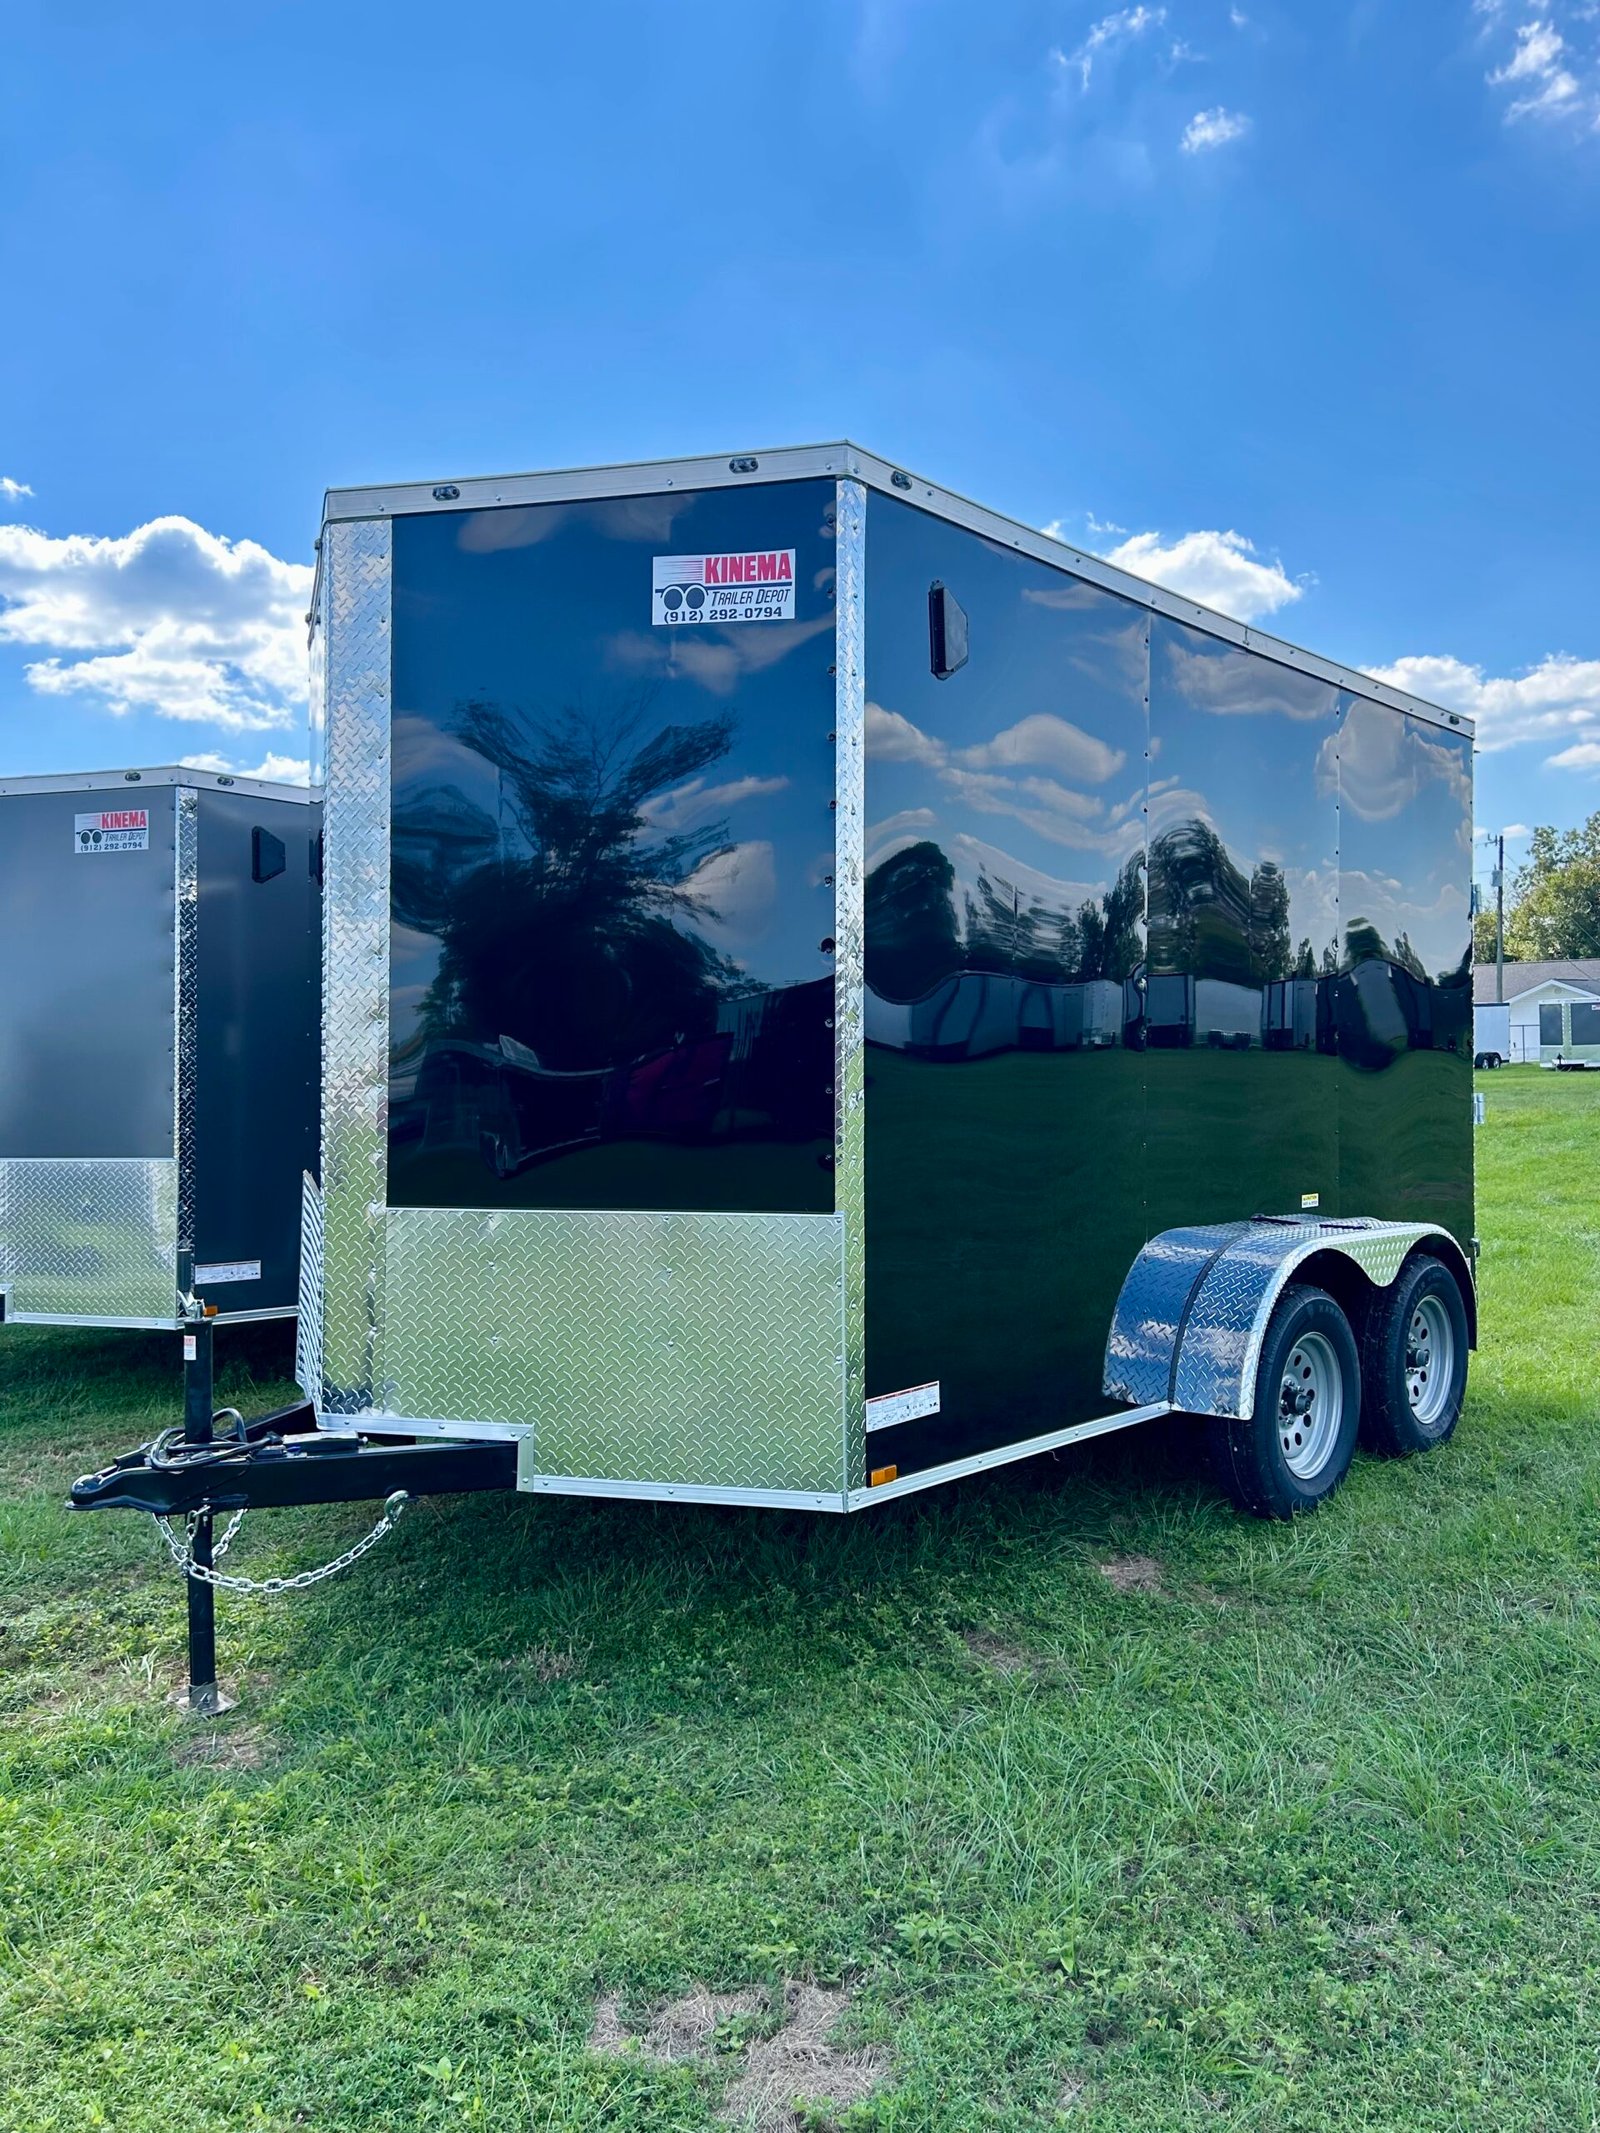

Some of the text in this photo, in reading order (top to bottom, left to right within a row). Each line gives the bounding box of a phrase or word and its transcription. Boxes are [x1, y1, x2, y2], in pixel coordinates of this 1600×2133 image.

[704, 552, 792, 584] KINEMA
[711, 588, 791, 607] TRAILER DEPOT
[664, 606, 782, 624] (912) 292-0794
[101, 811, 147, 829] KINEMA
[105, 831, 146, 842] TRAILER DEPOT
[80, 841, 142, 852] (912) 292-0794
